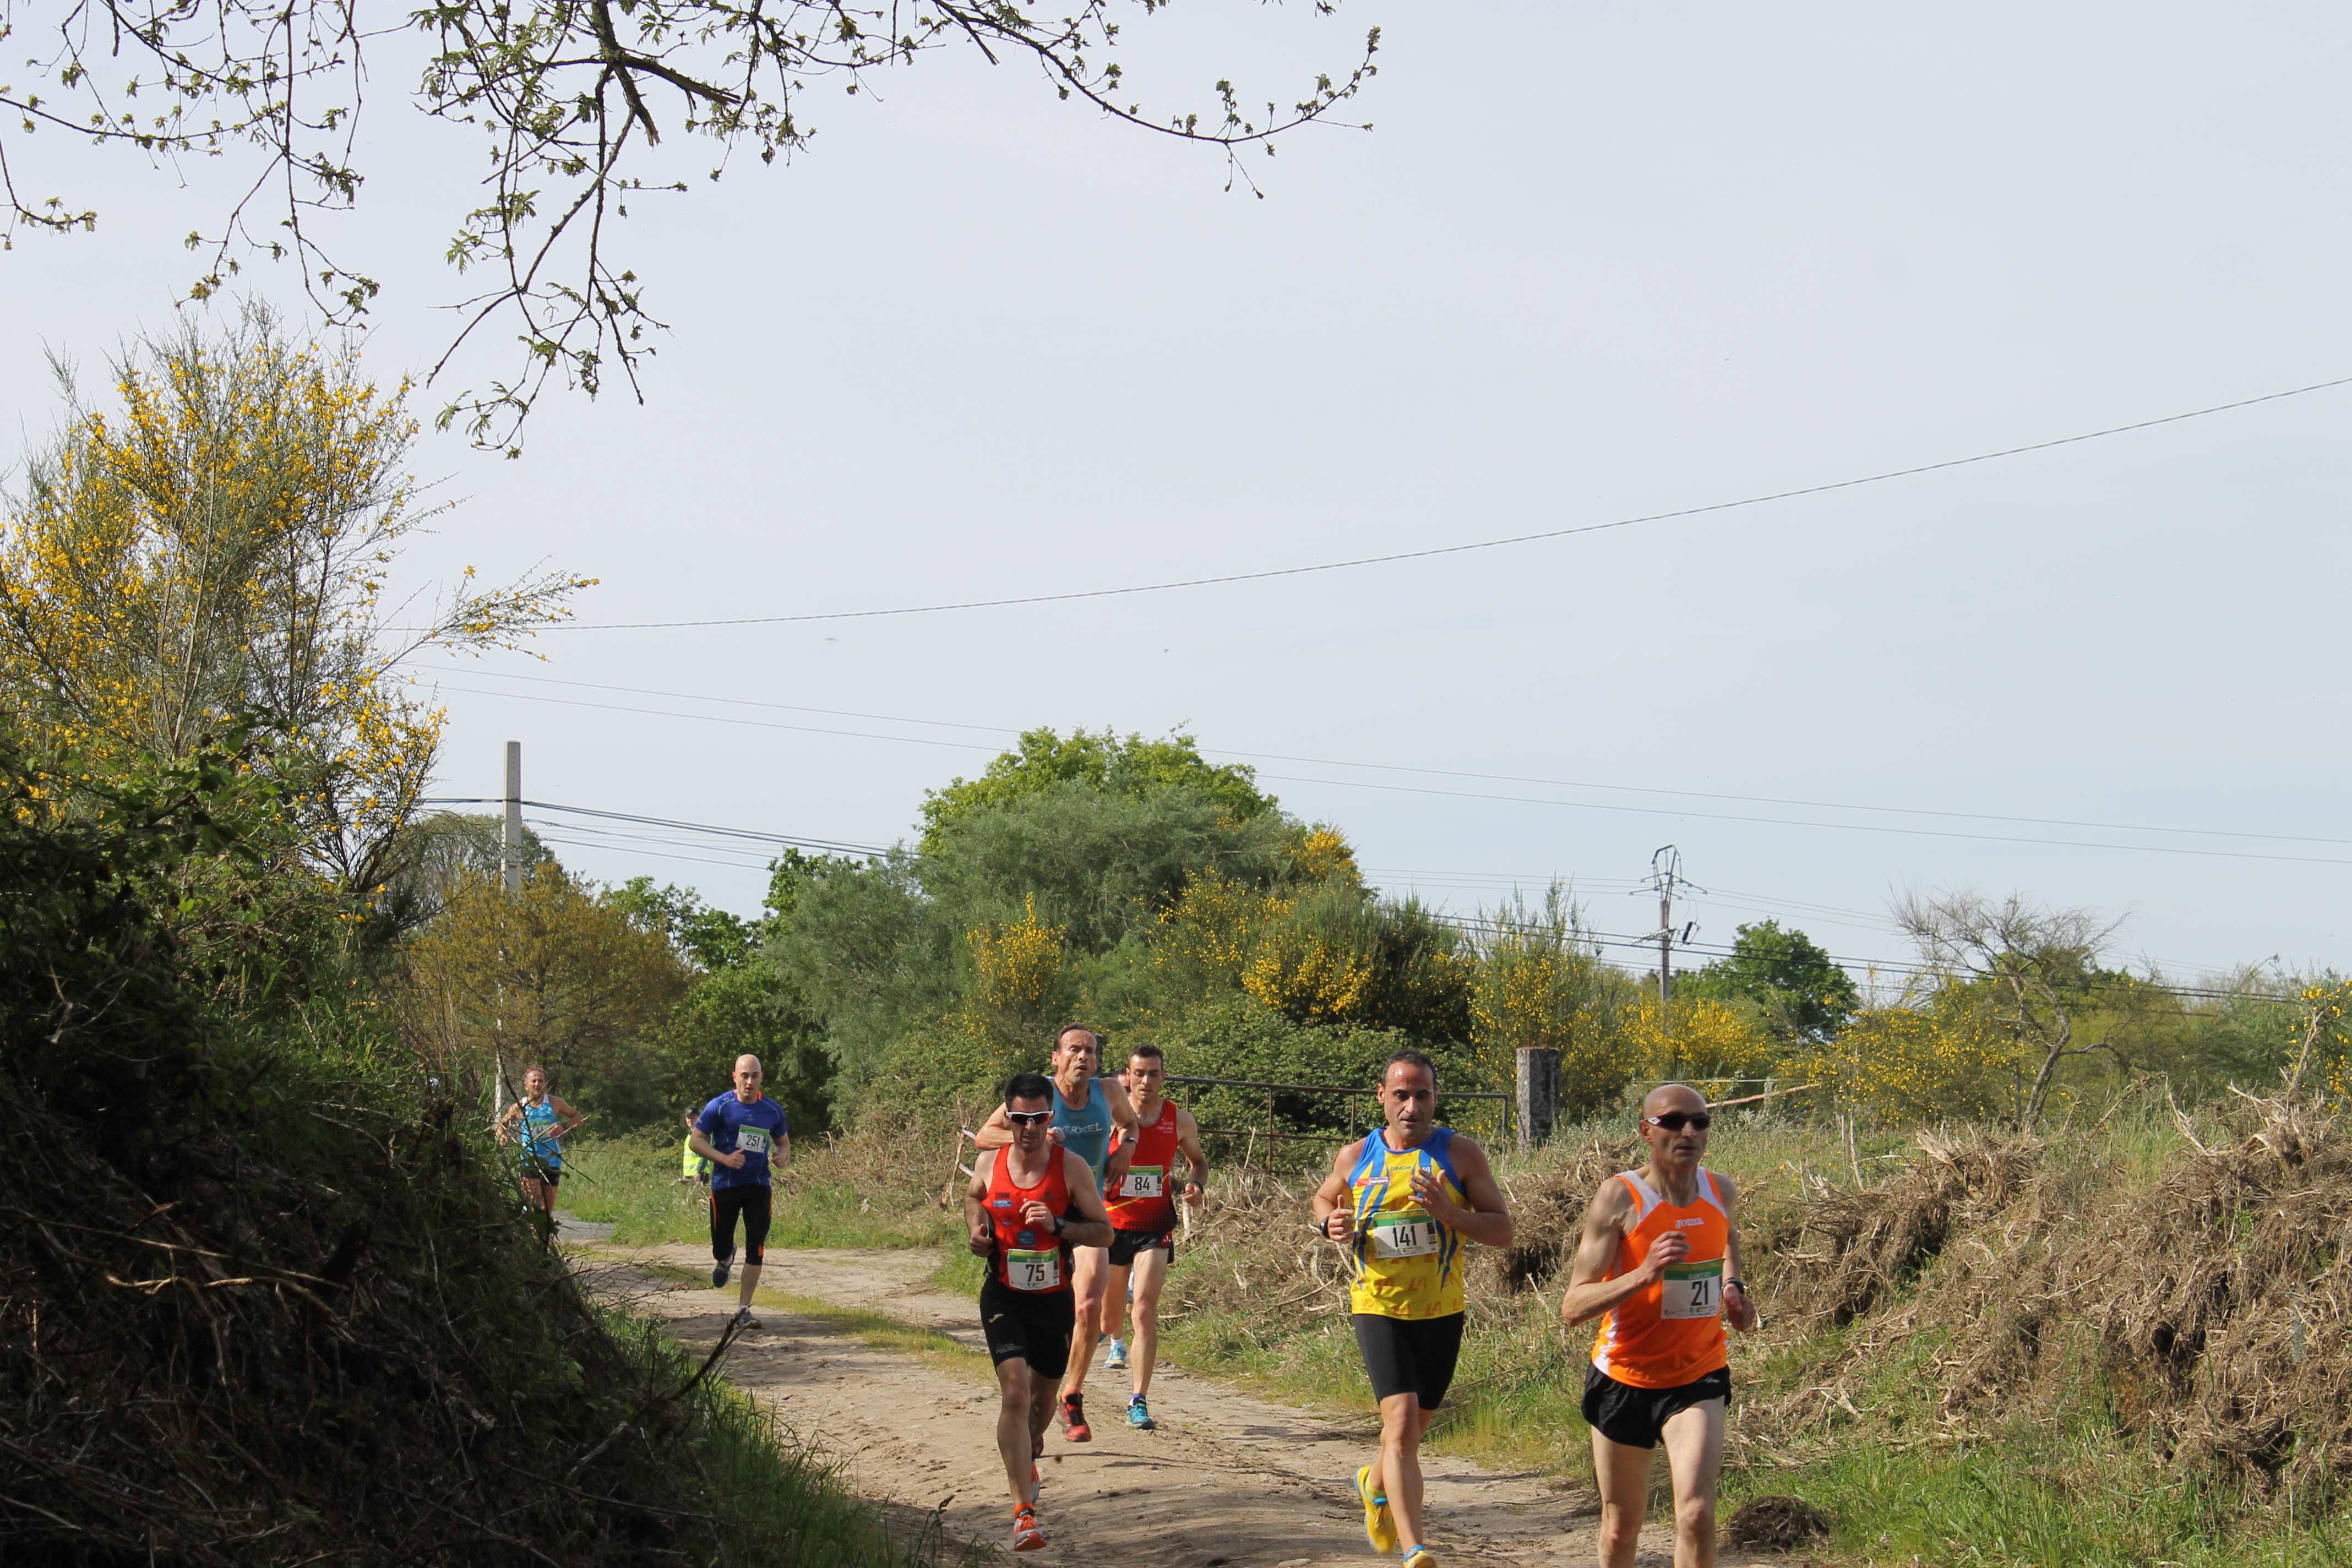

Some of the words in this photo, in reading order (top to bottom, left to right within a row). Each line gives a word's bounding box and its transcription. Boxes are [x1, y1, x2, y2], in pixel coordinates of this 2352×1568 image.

[745, 1135, 760, 1147] 251
[1135, 1177, 1150, 1191] 84
[1393, 1226, 1417, 1248] 141
[1025, 1264, 1044, 1282] 75
[1408, 1276, 1428, 1292] LA
[1691, 1280, 1708, 1306] 21
